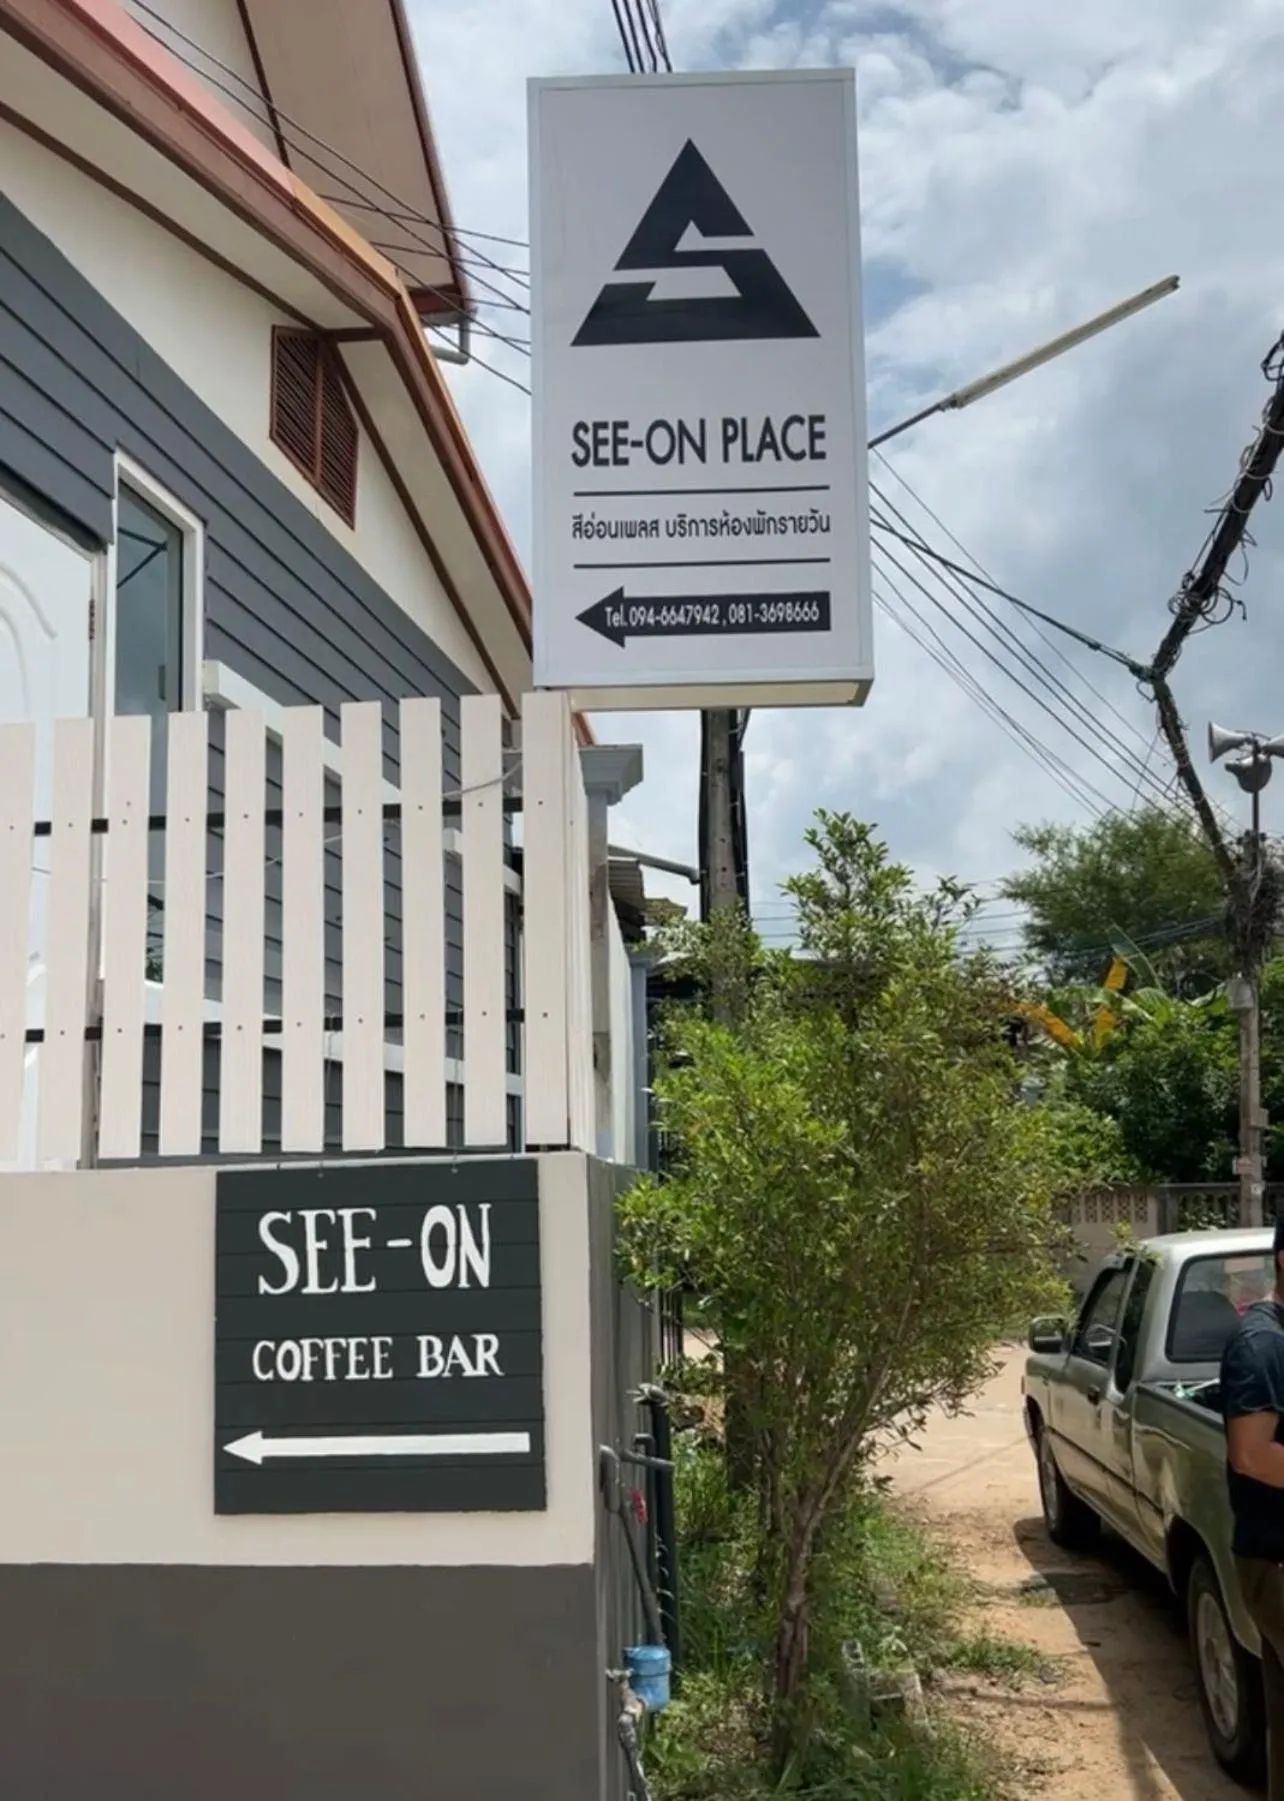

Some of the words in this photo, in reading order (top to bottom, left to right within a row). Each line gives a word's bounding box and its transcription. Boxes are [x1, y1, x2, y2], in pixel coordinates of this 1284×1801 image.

[571, 417, 706, 468] SEE-ON
[721, 414, 827, 463] PLACE
[571, 511, 660, 540] สีอ่อนเพลส
[665, 507, 831, 539] บริการห้องพักรายวัน
[252, 1336, 394, 1381] COFFEE
[415, 1333, 505, 1379] BAR
